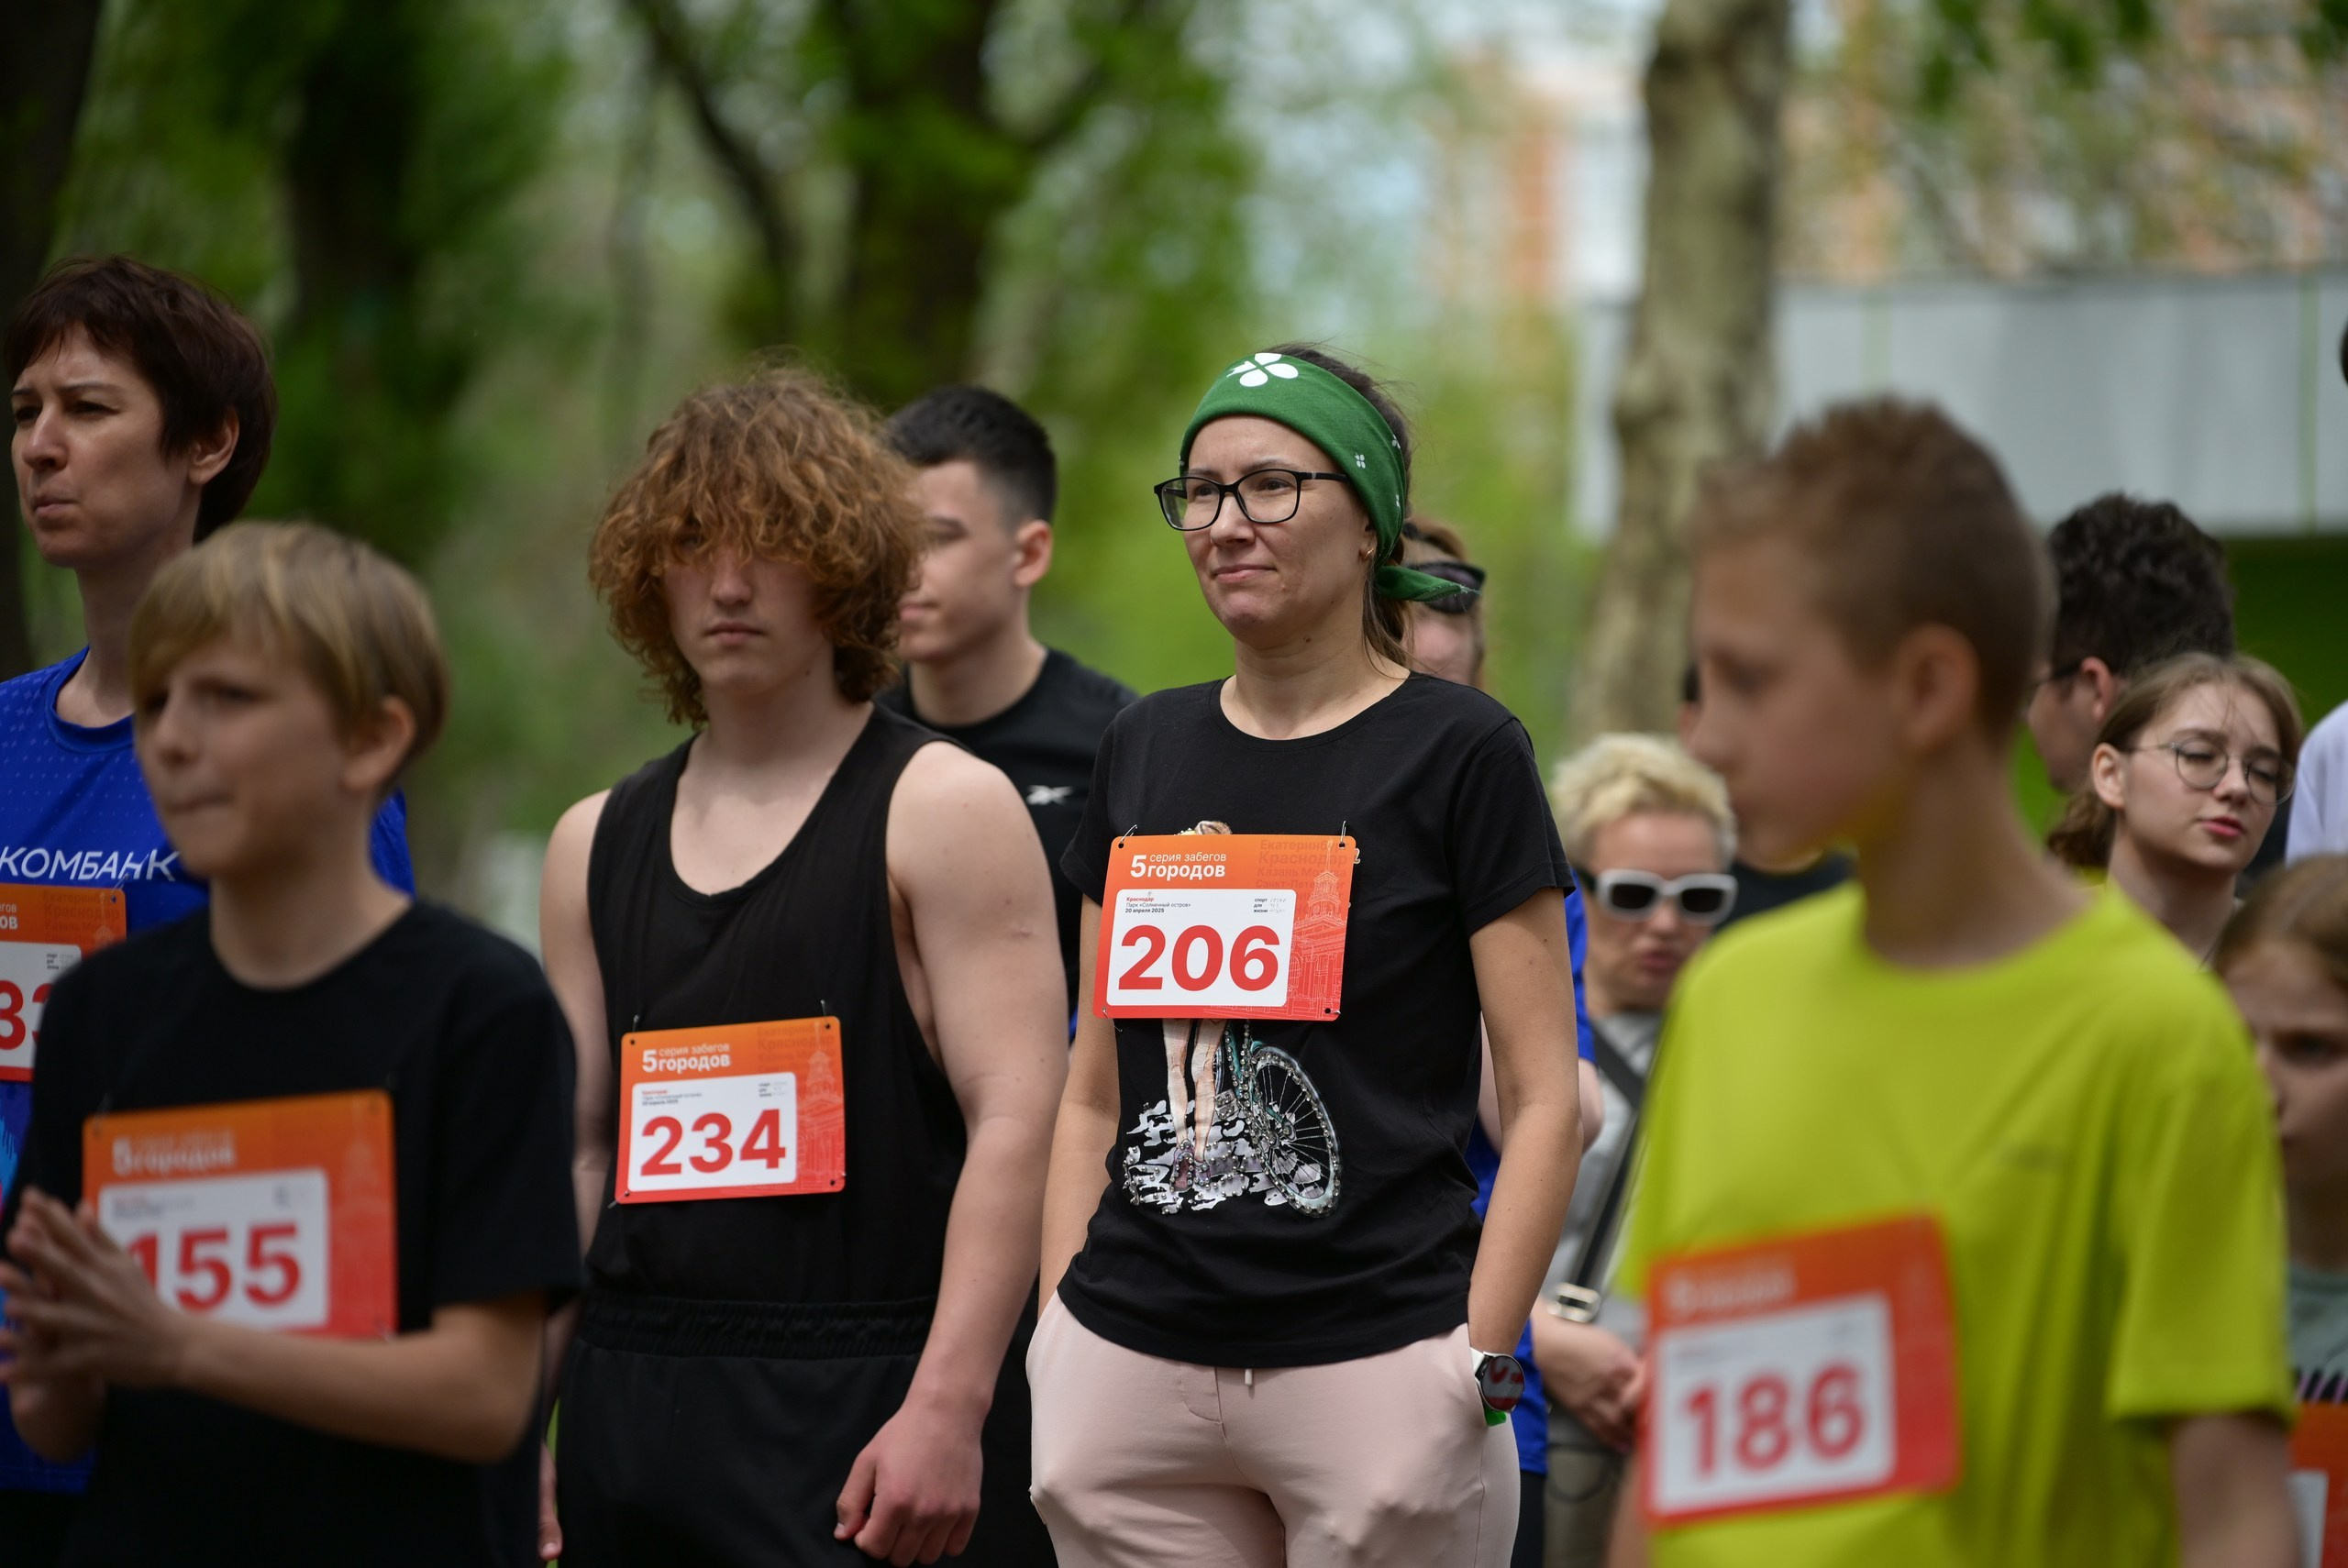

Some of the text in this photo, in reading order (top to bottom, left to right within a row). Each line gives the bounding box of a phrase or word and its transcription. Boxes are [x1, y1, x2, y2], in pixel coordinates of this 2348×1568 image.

[0, 845, 181, 882] КОМБАНК
[1130, 855, 1225, 881] 5 городов
[1149, 852, 1227, 864] серия забегов
[1258, 851, 1347, 867] Краснодар
[1117, 923, 1280, 992] 206
[642, 1049, 731, 1074] 5 городов
[659, 1046, 689, 1057] серия
[639, 1108, 786, 1176] 234
[128, 1220, 301, 1318] 155
[1685, 1361, 1866, 1483] 186
